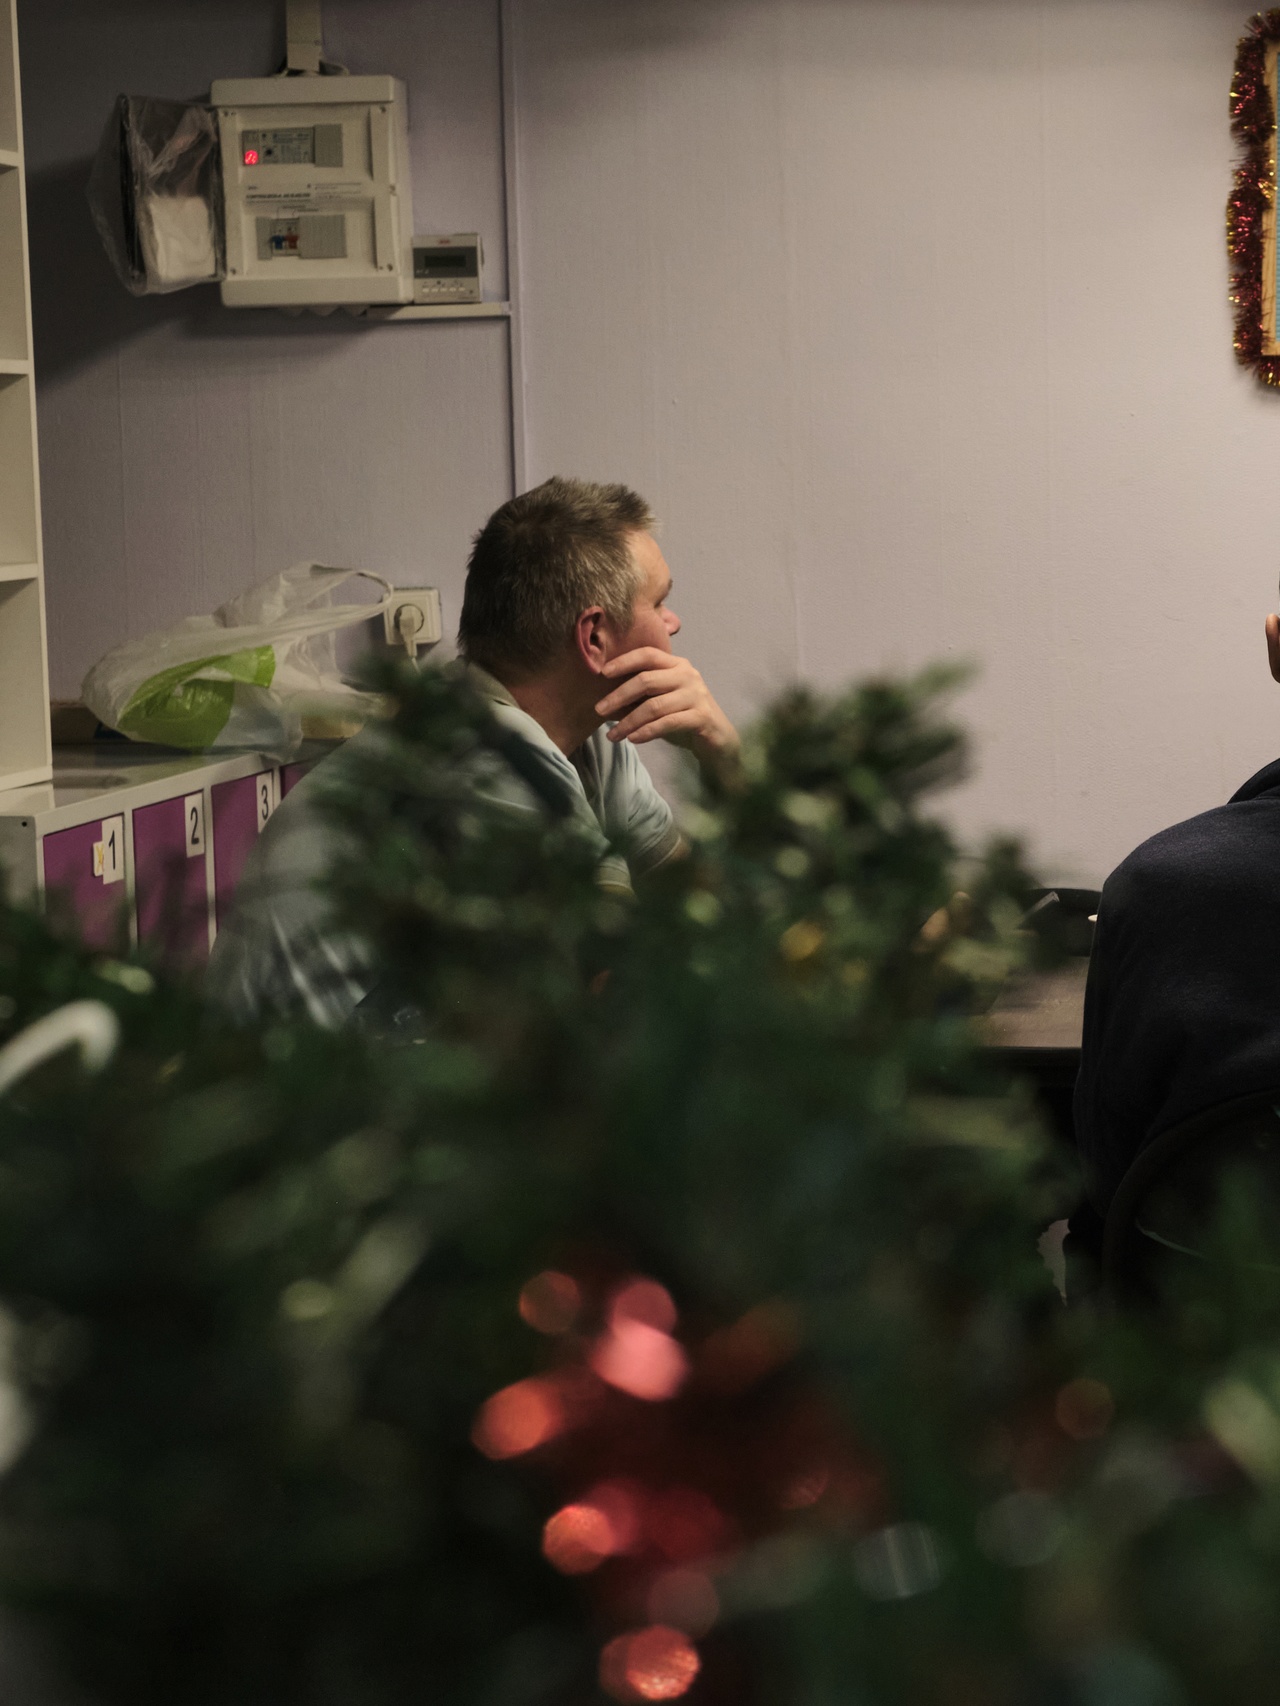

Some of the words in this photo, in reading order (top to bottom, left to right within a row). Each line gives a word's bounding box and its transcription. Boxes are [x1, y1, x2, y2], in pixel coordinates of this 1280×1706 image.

[261, 785, 269, 820] 3
[190, 807, 199, 844] 2
[108, 830, 116, 869] 1
